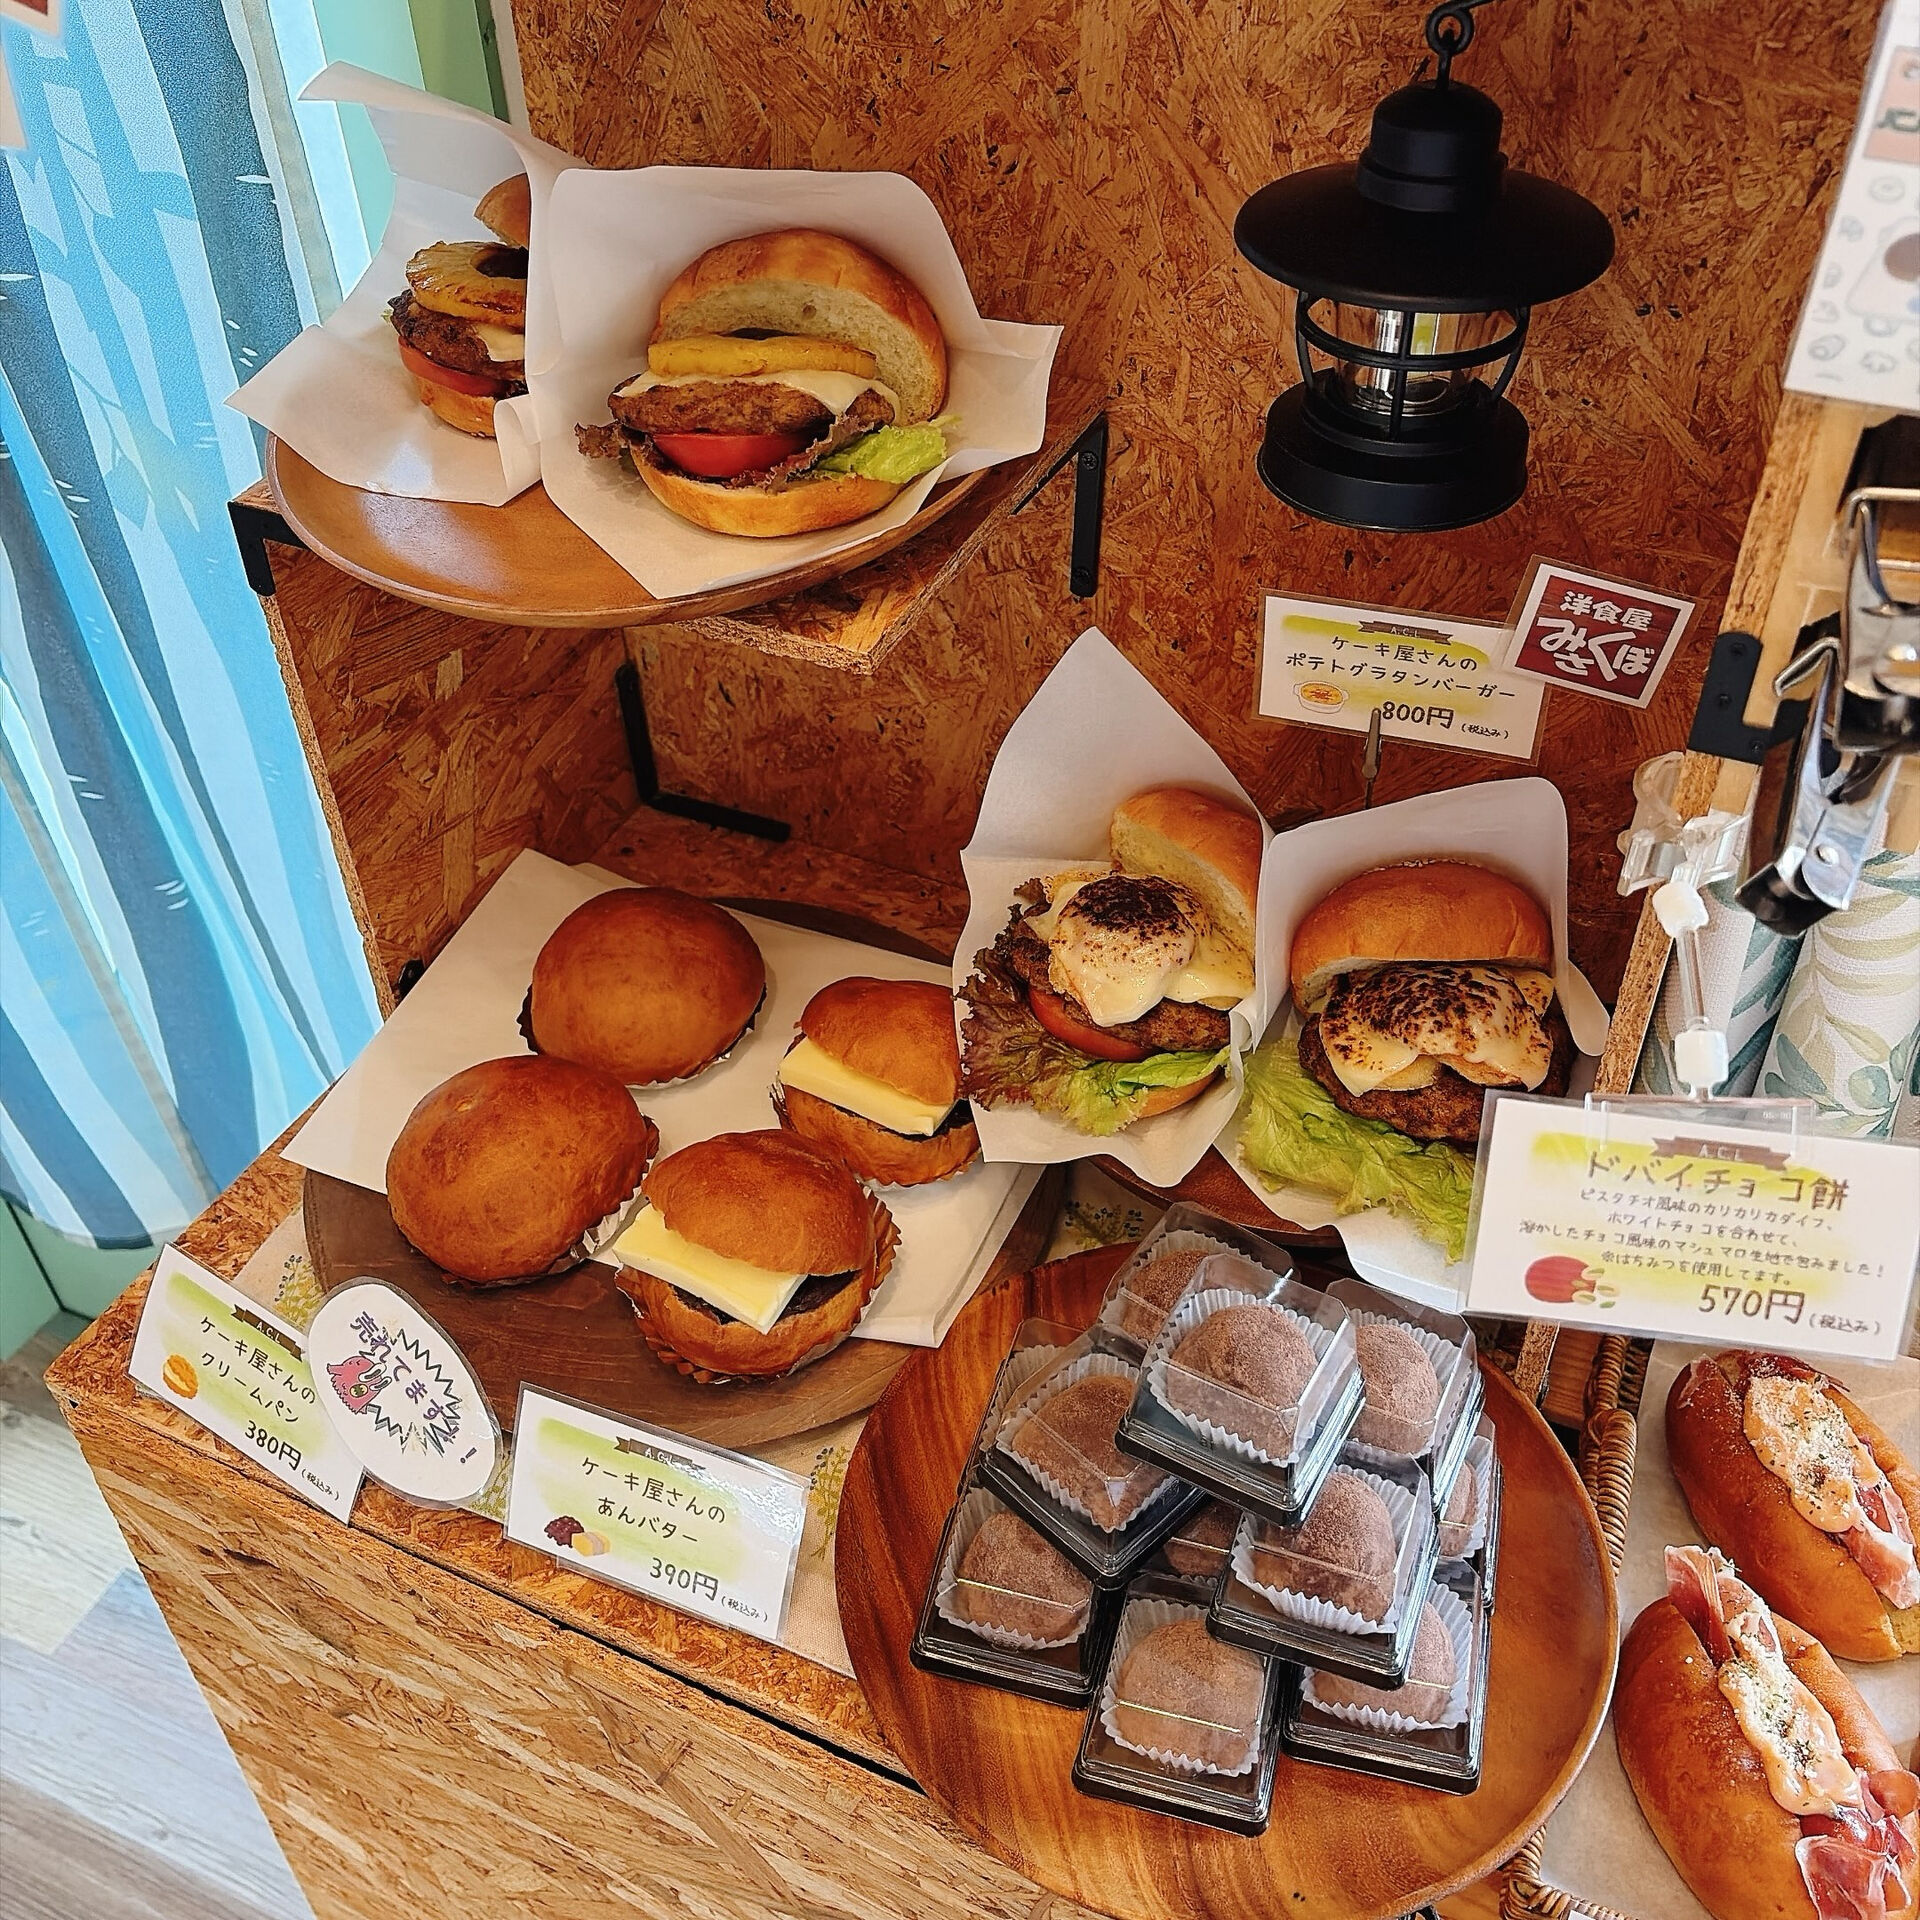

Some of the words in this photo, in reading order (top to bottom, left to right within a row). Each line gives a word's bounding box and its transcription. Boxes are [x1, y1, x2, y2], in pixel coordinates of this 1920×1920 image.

[1559, 591, 1653, 631] 洋食屋
[1286, 652, 1515, 698] ポテトグラタンバーガー
[1331, 636, 1477, 671] ケーキ屋さんの
[1382, 701, 1454, 729] 800円
[1588, 1151, 1849, 1211] ドバイチョコ餅
[1607, 1212, 1798, 1247] ホワイトチョコを合わせて、
[1699, 1284, 1805, 1325] 570円
[200, 1317, 316, 1404] ケーキ屋さんの
[201, 1353, 299, 1424] クリームパン
[244, 1420, 302, 1472] 380円
[581, 1457, 726, 1524] ケーキ屋さんの
[597, 1497, 698, 1543] あんバター
[650, 1557, 718, 1601] 390円
